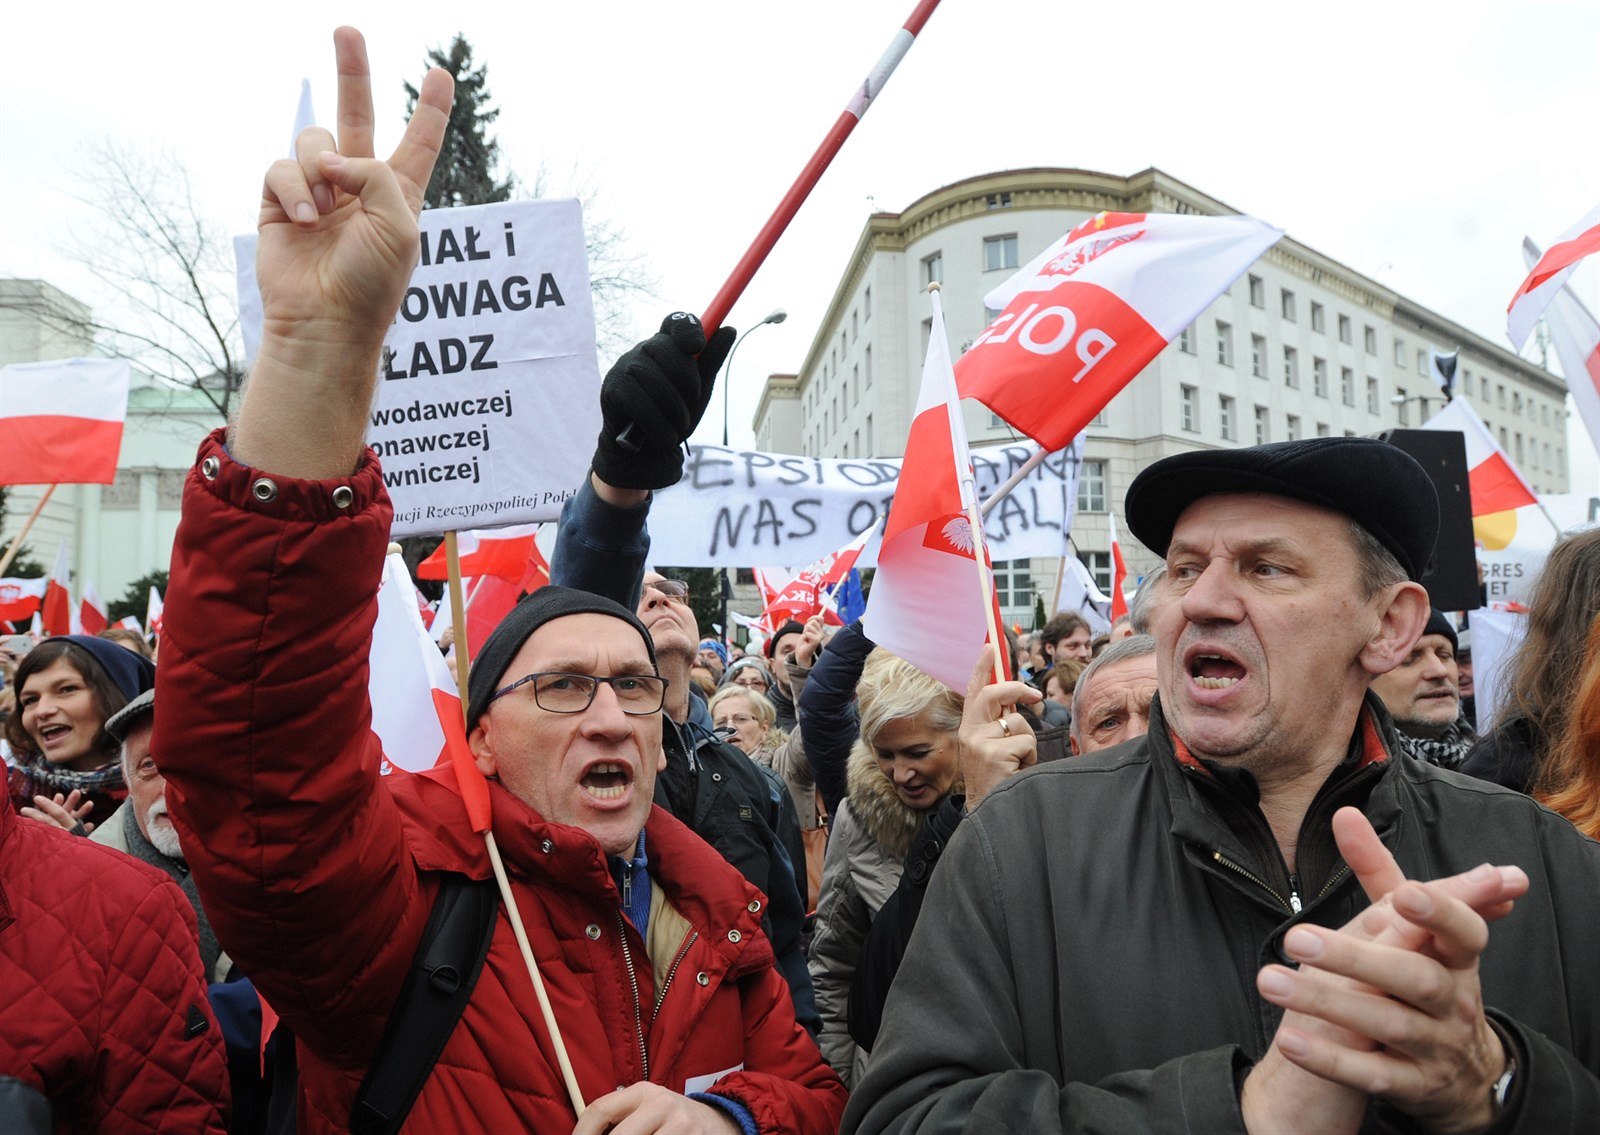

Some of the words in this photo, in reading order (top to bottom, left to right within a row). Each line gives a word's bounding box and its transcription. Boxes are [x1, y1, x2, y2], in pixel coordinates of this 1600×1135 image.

[419, 226, 491, 266] IAŁ
[504, 222, 516, 257] i
[398, 272, 566, 323] OWAGA
[382, 334, 498, 381] ŁADZ
[371, 389, 513, 427] wodawczej
[369, 423, 490, 458] onawczej
[382, 456, 480, 488] wniczej
[393, 507, 421, 524] ucji
[426, 493, 538, 519] Rzeczypospolitej
[709, 498, 822, 557] NAS
[1491, 581, 1509, 595] ET
